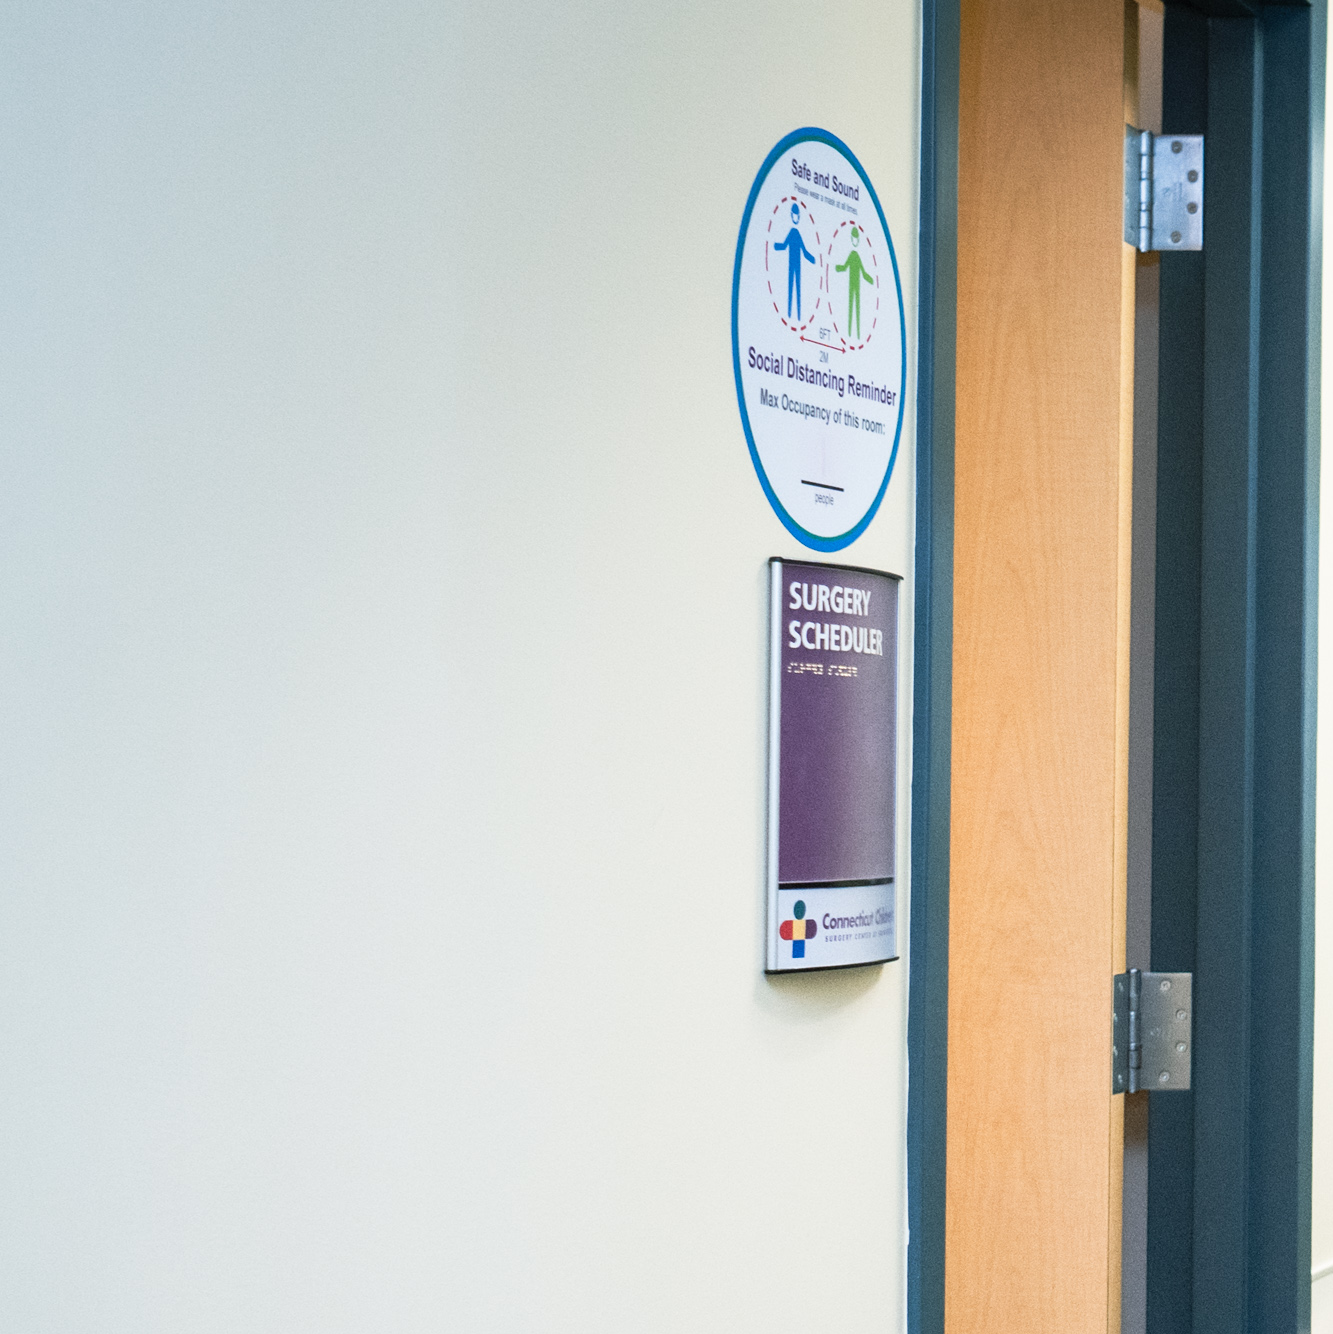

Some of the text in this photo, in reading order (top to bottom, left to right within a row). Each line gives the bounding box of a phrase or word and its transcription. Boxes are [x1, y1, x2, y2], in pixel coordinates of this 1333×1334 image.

[792, 158, 860, 201] Safe and Sound
[748, 346, 896, 406] Social Distancing Reminder
[760, 388, 886, 436] Max Occupancy of this room:
[815, 493, 834, 507] people
[788, 582, 872, 616] SURGERY
[788, 620, 883, 656] SCHEDULER
